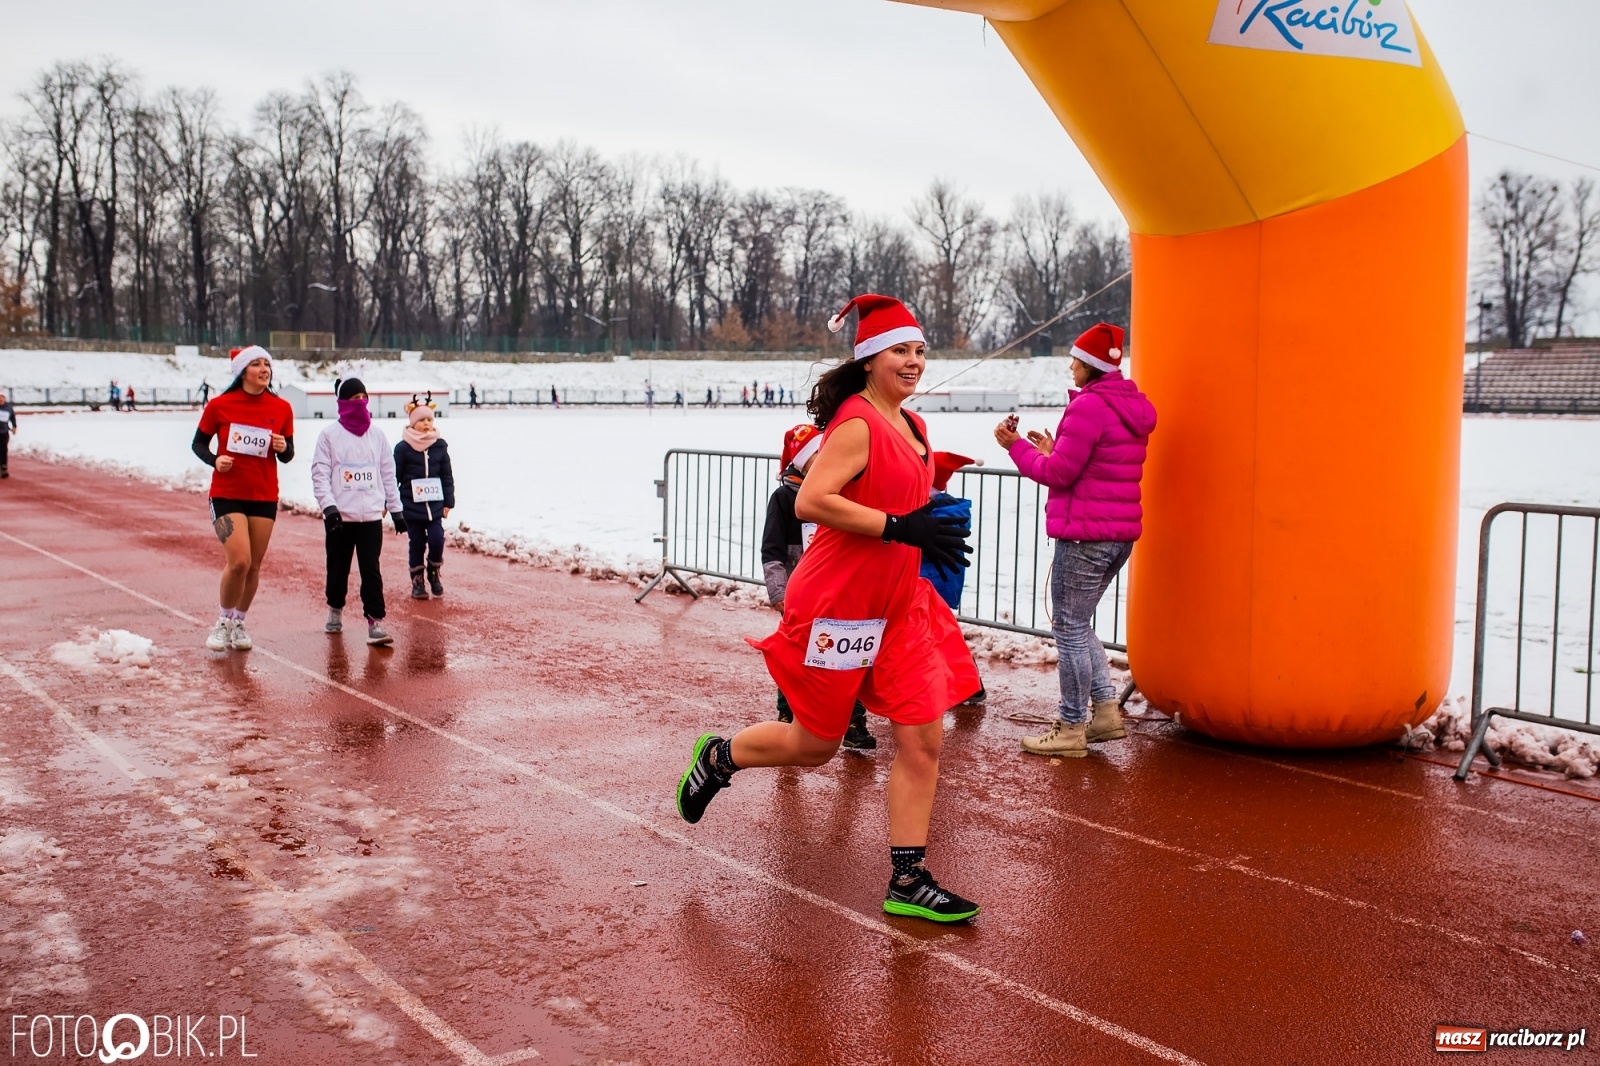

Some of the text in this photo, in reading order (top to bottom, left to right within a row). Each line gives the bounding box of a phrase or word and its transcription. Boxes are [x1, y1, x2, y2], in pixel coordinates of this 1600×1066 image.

[243, 435, 266, 448] 049
[354, 472, 373, 482] 018
[424, 486, 440, 495] 032
[836, 635, 875, 655] 046
